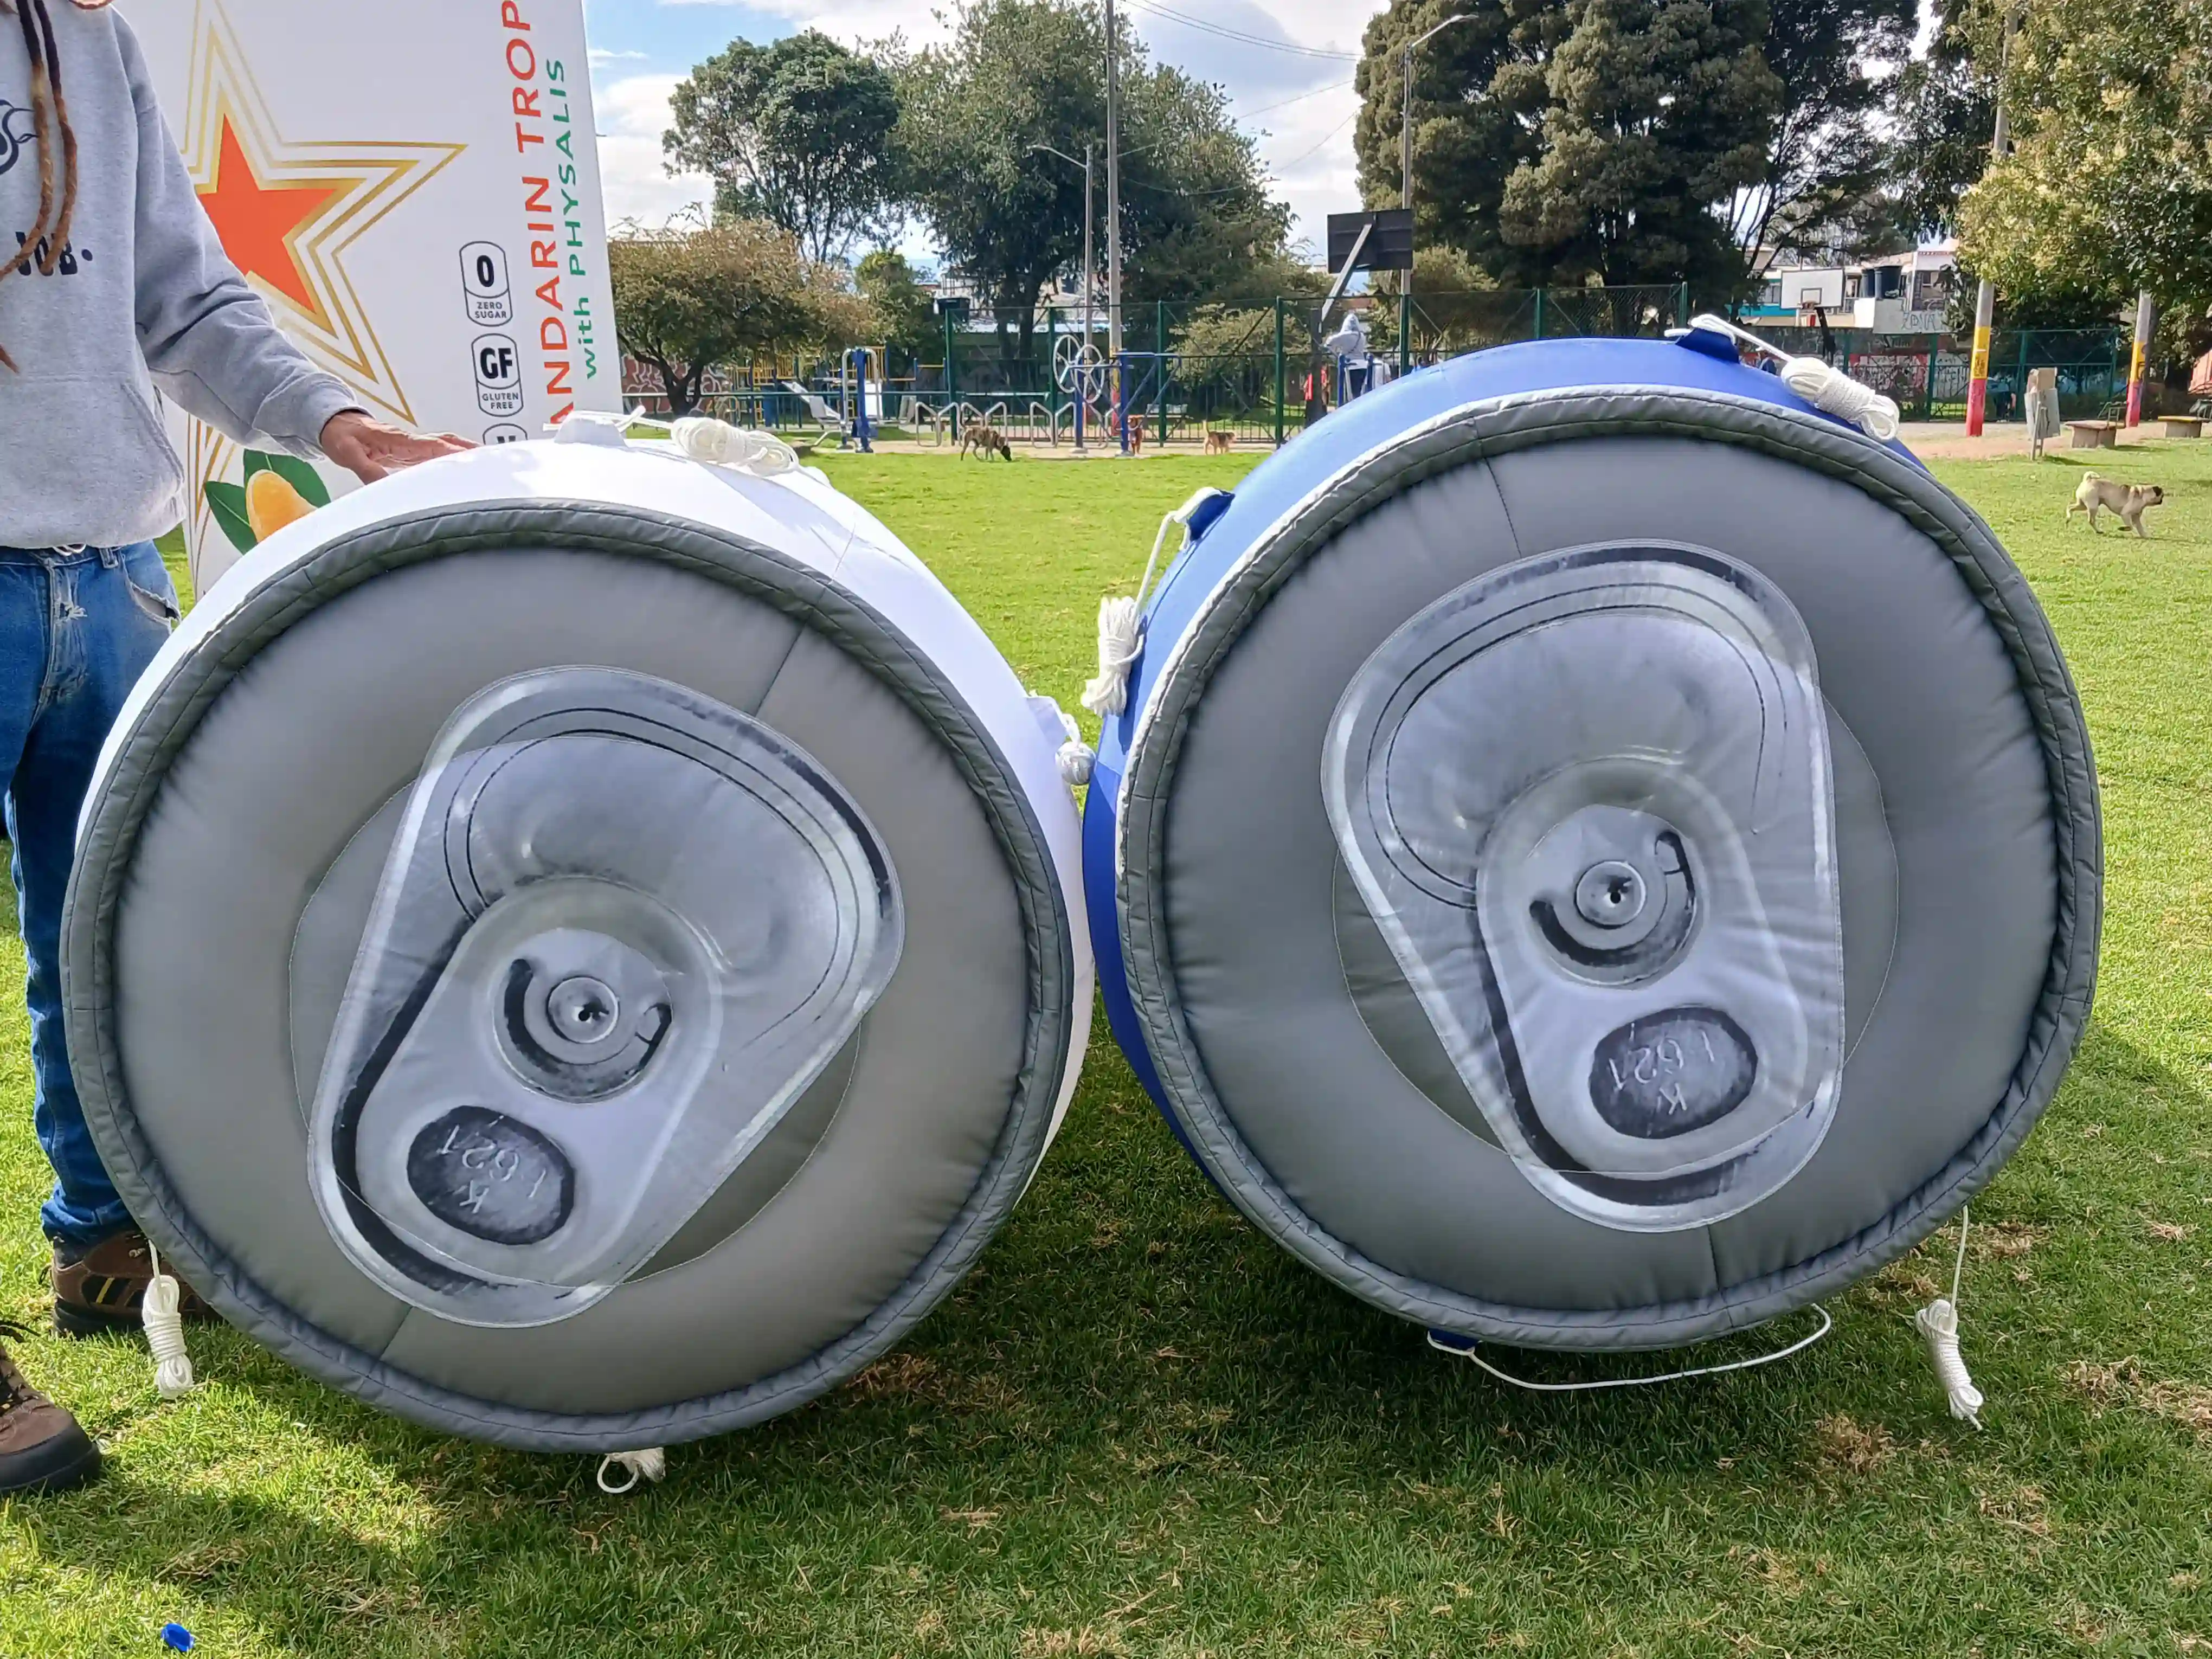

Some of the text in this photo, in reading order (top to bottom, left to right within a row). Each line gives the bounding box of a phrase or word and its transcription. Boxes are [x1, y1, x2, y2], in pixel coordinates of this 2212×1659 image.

[501, 0, 544, 153] TROP
[546, 58, 597, 380] with PHYSALIS
[477, 301, 503, 310] ZERO
[474, 310, 507, 319] SUGAR
[480, 347, 513, 380] GF
[481, 393, 519, 401] GLUTEN
[490, 401, 514, 409] FREE
